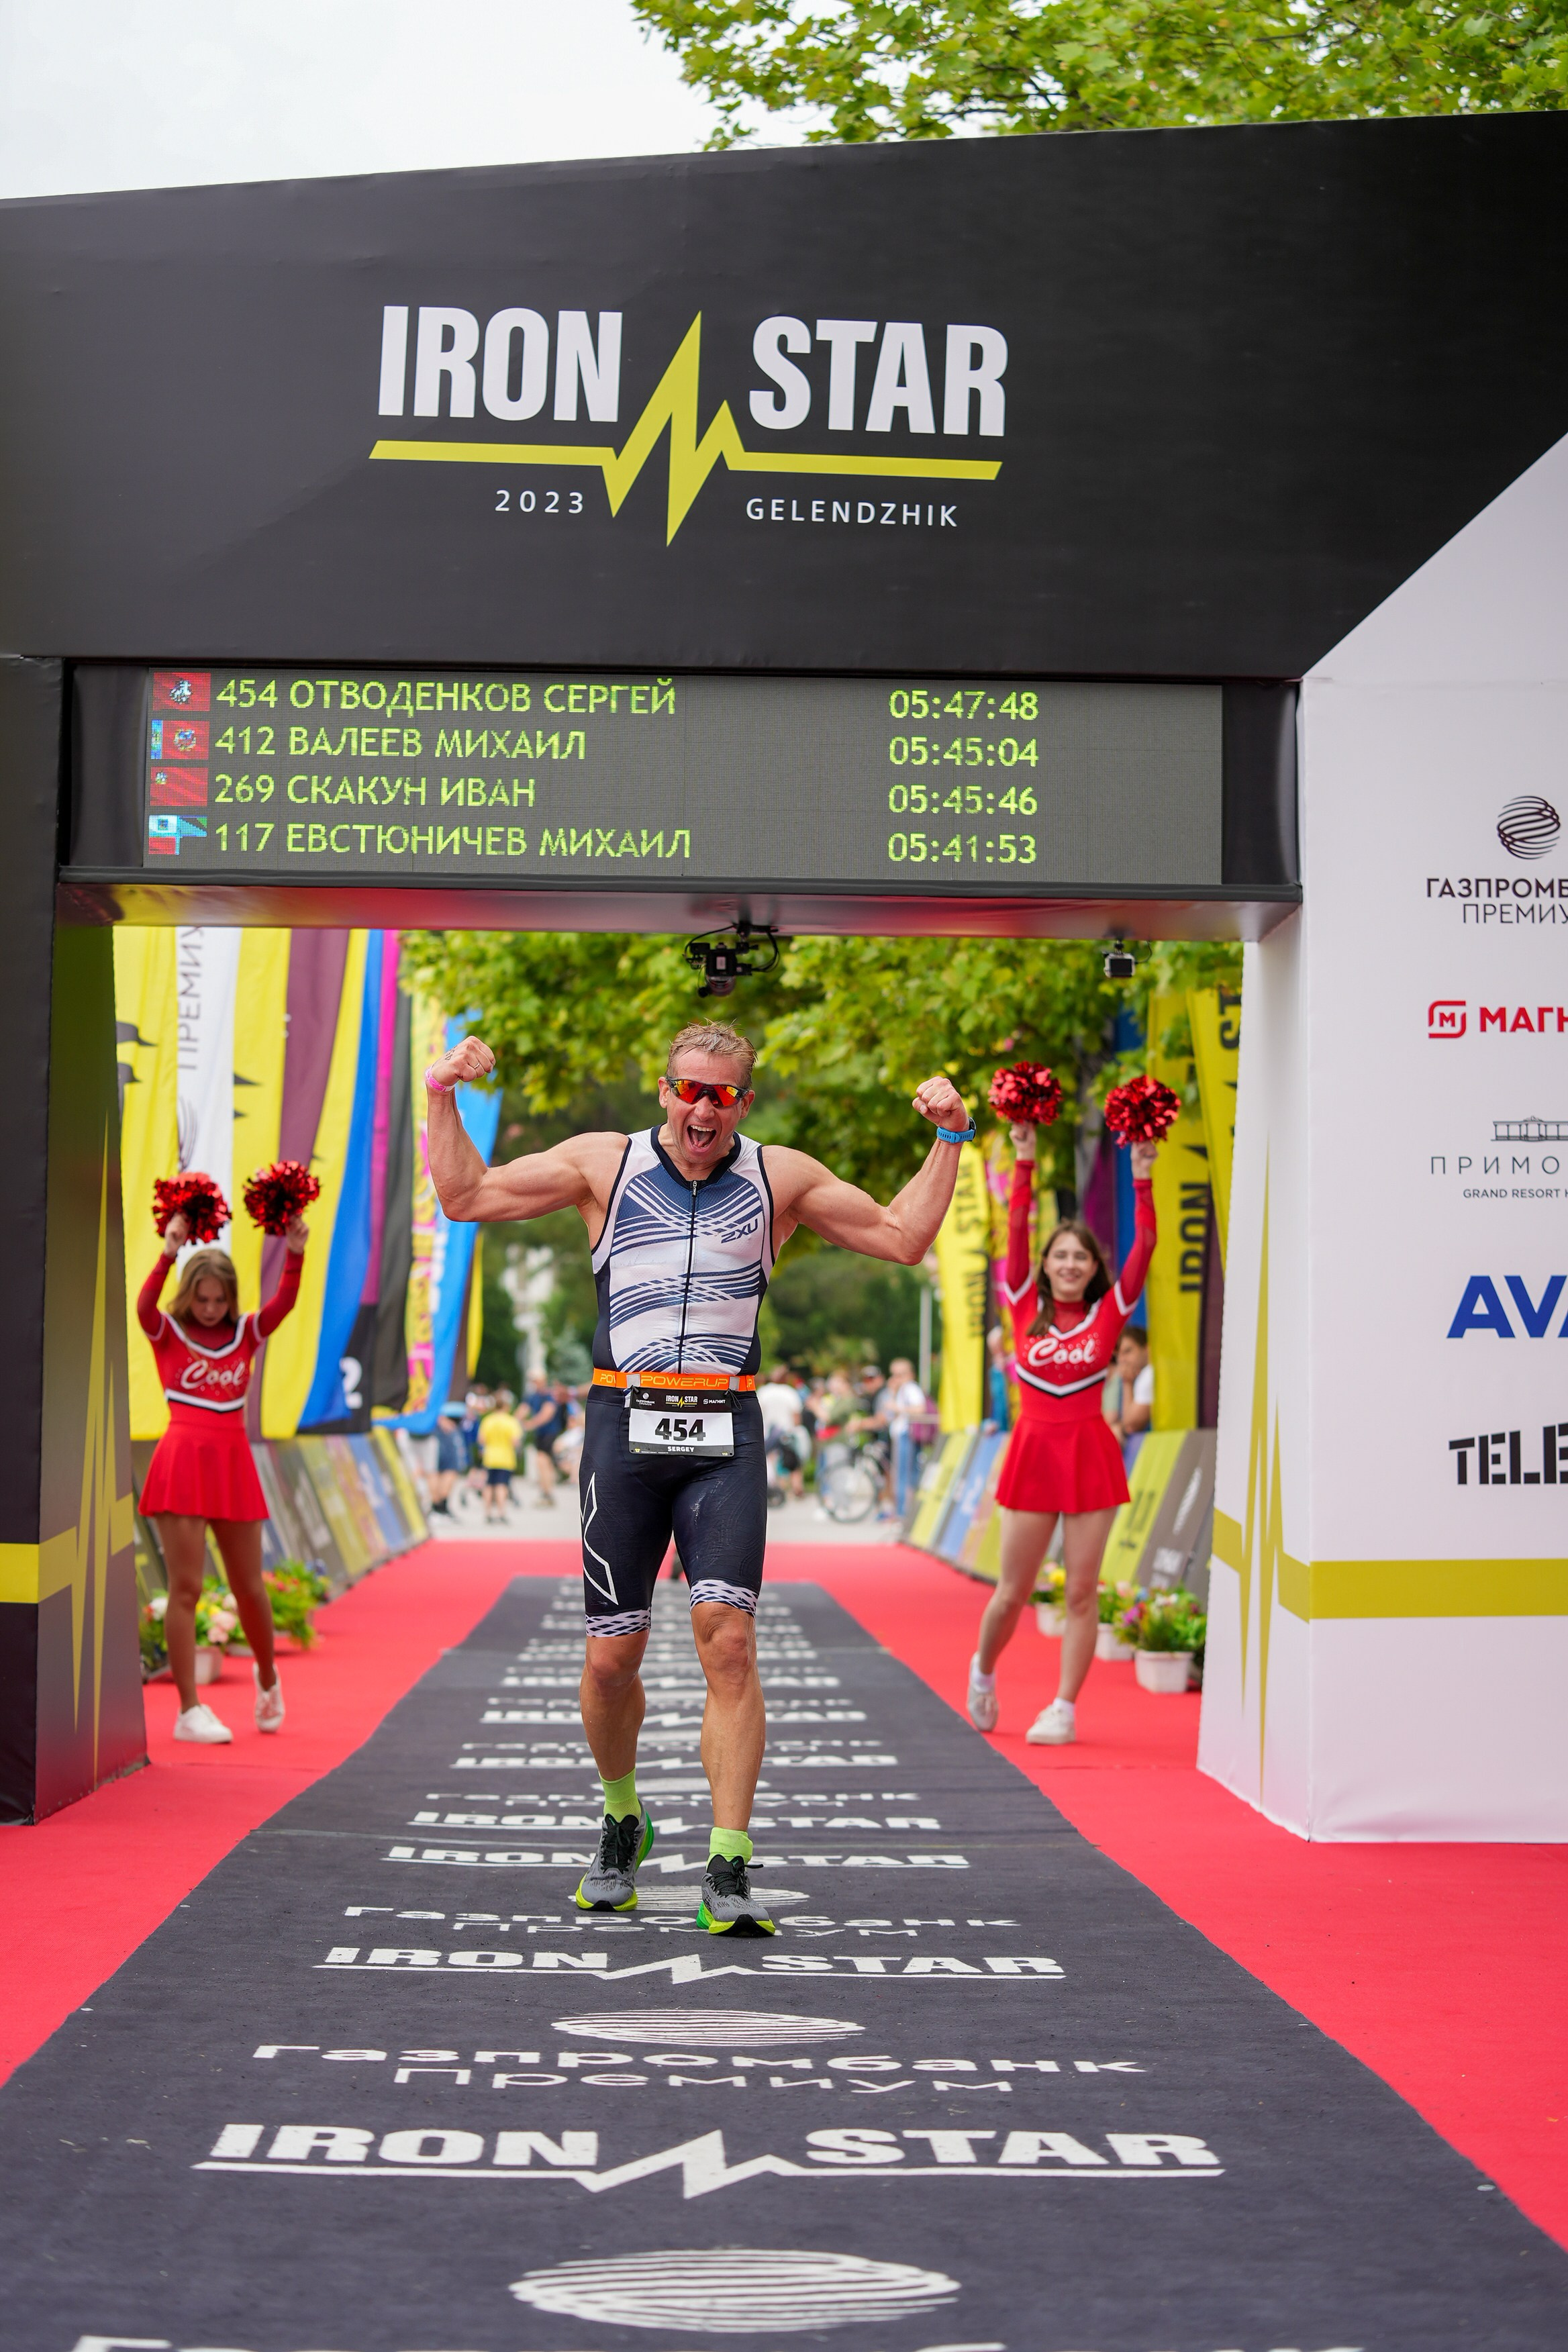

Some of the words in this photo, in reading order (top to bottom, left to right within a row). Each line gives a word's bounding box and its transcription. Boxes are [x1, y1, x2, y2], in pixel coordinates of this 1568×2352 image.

[378, 305, 623, 423] IRON
[749, 315, 1008, 436] STAR
[495, 490, 585, 514] 2023
[746, 497, 959, 527] GELENDZHIK
[216, 679, 277, 708] 454
[289, 681, 532, 718] ОТВОДЕНКОВ
[543, 678, 676, 715] СЕРГЕЙ
[889, 690, 1038, 720] 05:47:48
[215, 727, 276, 755] 412
[289, 728, 422, 757] ВАЛЕЕВ
[435, 730, 586, 760] МИХАИЛ
[889, 736, 1038, 767] 05:45:04
[215, 775, 275, 803] 269
[287, 776, 427, 805] СКАКУН
[441, 778, 535, 807] ИВАН
[888, 784, 1038, 815] 05:45:46
[215, 823, 275, 852] 117
[287, 824, 528, 855] ЕВСТЮНИЧЕВ
[539, 828, 691, 859] МИХАИЛ
[887, 833, 1037, 863] 05:41:53
[1431, 1156, 1560, 1175] ПРИМО
[1463, 1189, 1508, 1198] GRAND
[1512, 1189, 1561, 1198] RESORT
[721, 1218, 758, 1244] 2XU
[1447, 1275, 1568, 1338] AV
[1028, 1337, 1096, 1367] Cool
[181, 1359, 246, 1390] Cool
[640, 1374, 729, 1387] POWERUP
[654, 1418, 706, 1441] 454
[344, 1906, 1021, 1928] Газпробанк
[324, 1947, 607, 1969] IRON
[762, 1955, 1064, 1973] STAR
[253, 2045, 1148, 2072] Газпромбанк
[394, 2069, 1014, 2093] Премиум
[210, 2124, 599, 2165] IRON
[805, 2128, 1220, 2165] STAR
